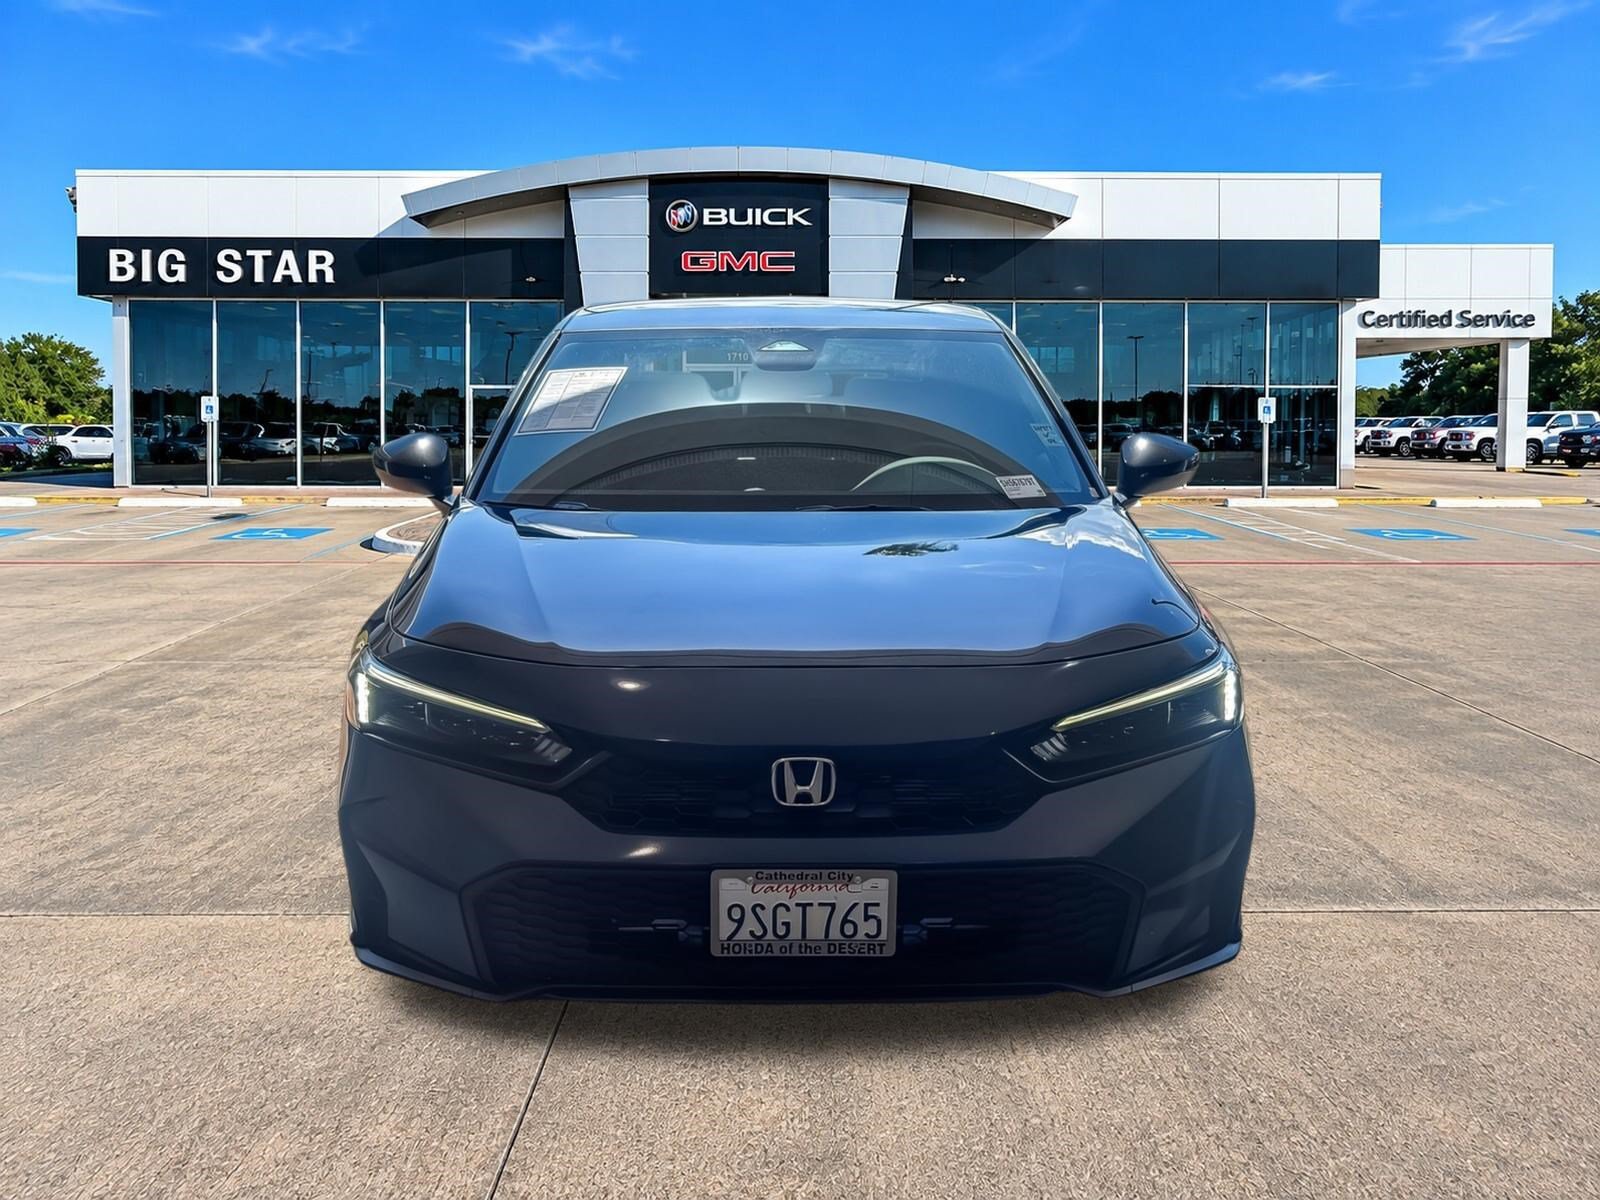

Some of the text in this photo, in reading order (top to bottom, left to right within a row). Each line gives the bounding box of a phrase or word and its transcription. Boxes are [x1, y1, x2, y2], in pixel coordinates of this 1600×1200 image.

[703, 207, 813, 226] BUICK
[108, 249, 335, 284] BIG STAR
[681, 251, 796, 272] GMC
[1359, 309, 1535, 329] Certified Service
[727, 352, 749, 361] 1710
[755, 871, 854, 883] Cathedral City
[727, 902, 882, 941] 9SGT765
[721, 943, 886, 955] HONDA of the DESERT
